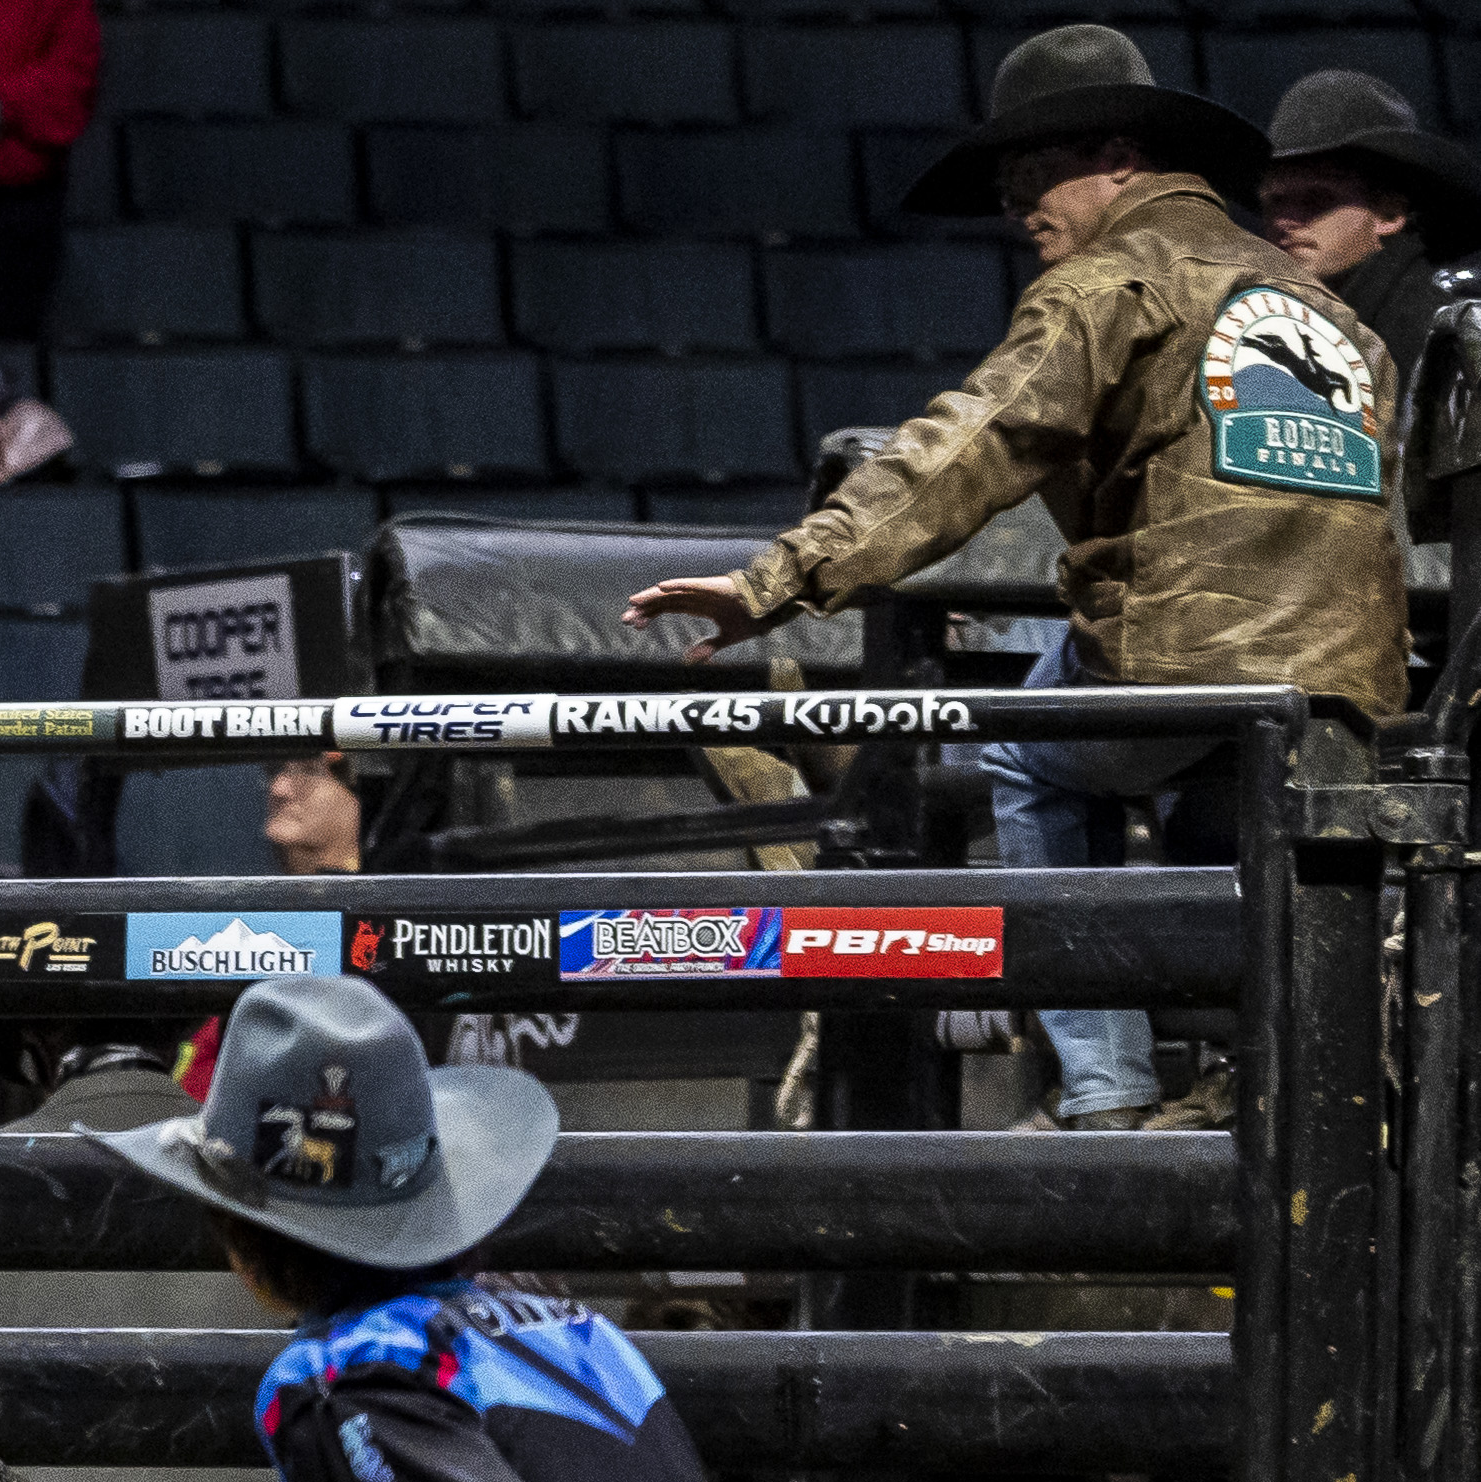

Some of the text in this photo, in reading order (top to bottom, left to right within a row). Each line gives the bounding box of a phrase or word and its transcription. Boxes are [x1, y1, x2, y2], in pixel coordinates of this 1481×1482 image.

[1264, 416, 1345, 457] RODEO
[1257, 448, 1357, 476] FINALS
[166, 601, 279, 661] COOPER
[43, 720, 94, 736] Patrol
[45, 707, 94, 720] States
[124, 706, 327, 737] BOOT BARN
[784, 695, 972, 735] Kubota
[373, 720, 504, 743] TIRES
[392, 919, 552, 959] PENDLETON
[595, 914, 747, 956] BEATBOX
[926, 932, 997, 955] Shop
[426, 959, 514, 973] WHISKY
